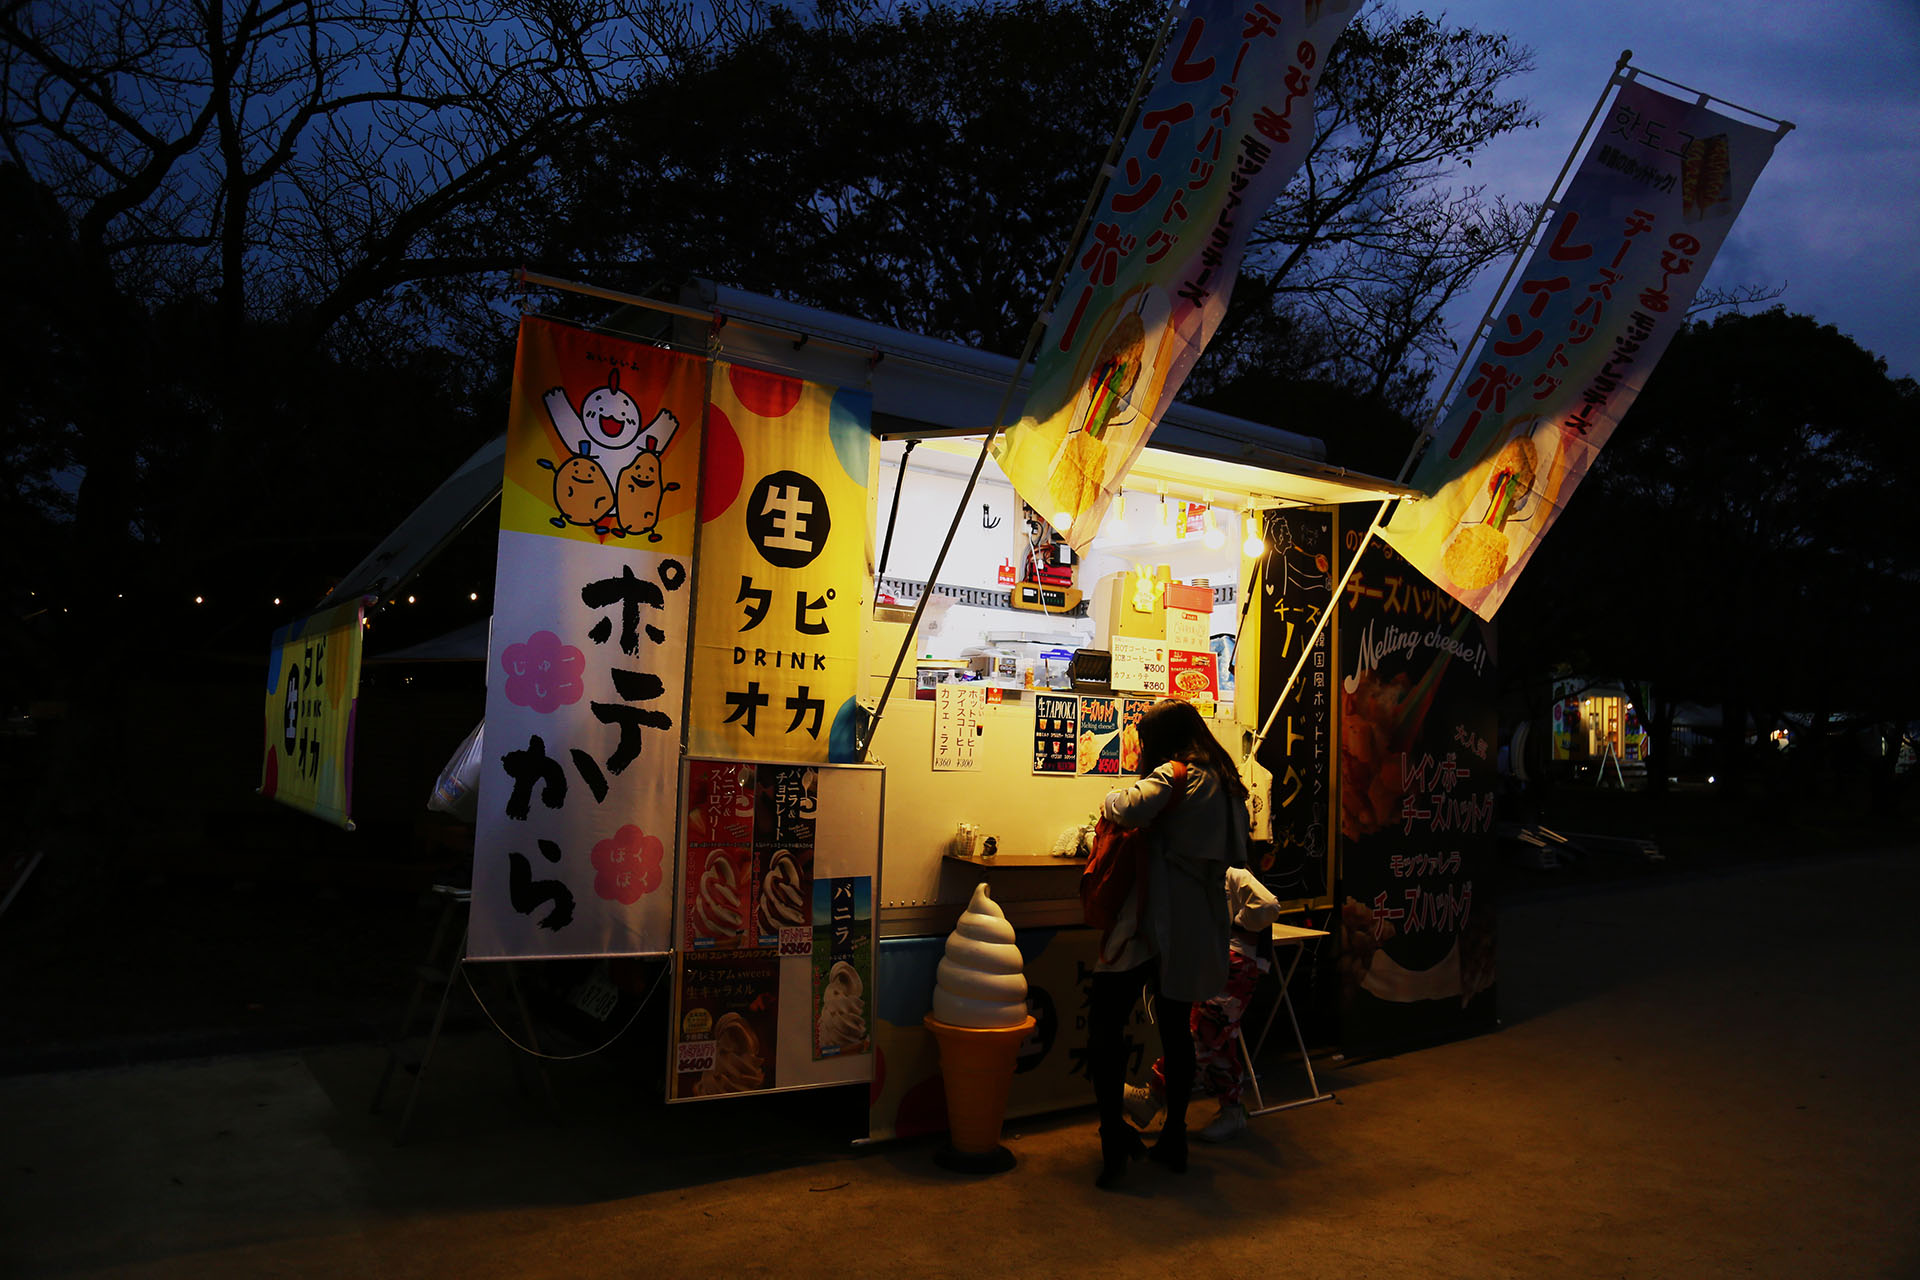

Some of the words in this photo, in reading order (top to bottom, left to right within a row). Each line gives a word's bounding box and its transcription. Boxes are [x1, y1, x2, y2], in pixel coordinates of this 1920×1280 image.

[1147, 3, 1282, 264] チーズハットグ
[1610, 105, 1695, 160] 핫도그
[1060, 18, 1216, 351] レインボー
[1534, 209, 1655, 400] チーズハットグ
[1449, 212, 1593, 459] レインボー
[1564, 311, 1655, 436] モッツァレラチーズ
[760, 485, 814, 553] 生
[735, 576, 836, 635] タピ
[1273, 598, 1321, 627] チーズ
[512, 656, 576, 676] じゅー
[733, 646, 827, 671] DRINK
[1144, 664, 1165, 673] ¥300
[1344, 617, 1423, 694] Melting
[1424, 623, 1487, 678] cheese!!
[535, 681, 573, 699] しー
[723, 682, 825, 741] オカ
[1080, 698, 1115, 723] チーズハットグ
[1143, 682, 1165, 691] ¥360
[940, 688, 950, 755] カフェ・ラテ
[956, 690, 967, 757] アイスコーヒー
[967, 690, 978, 757] ホットコーヒー
[935, 757, 952, 767] ¥360
[956, 758, 974, 768] ¥300
[1098, 758, 1119, 774] ¥500
[1401, 752, 1471, 793] レインボー
[708, 769, 722, 842] ストロベリー
[775, 771, 788, 841] チョコレート
[1402, 792, 1495, 837] チーズハットグ
[833, 883, 852, 945] バニラ
[1372, 880, 1473, 942] チーズハットグ
